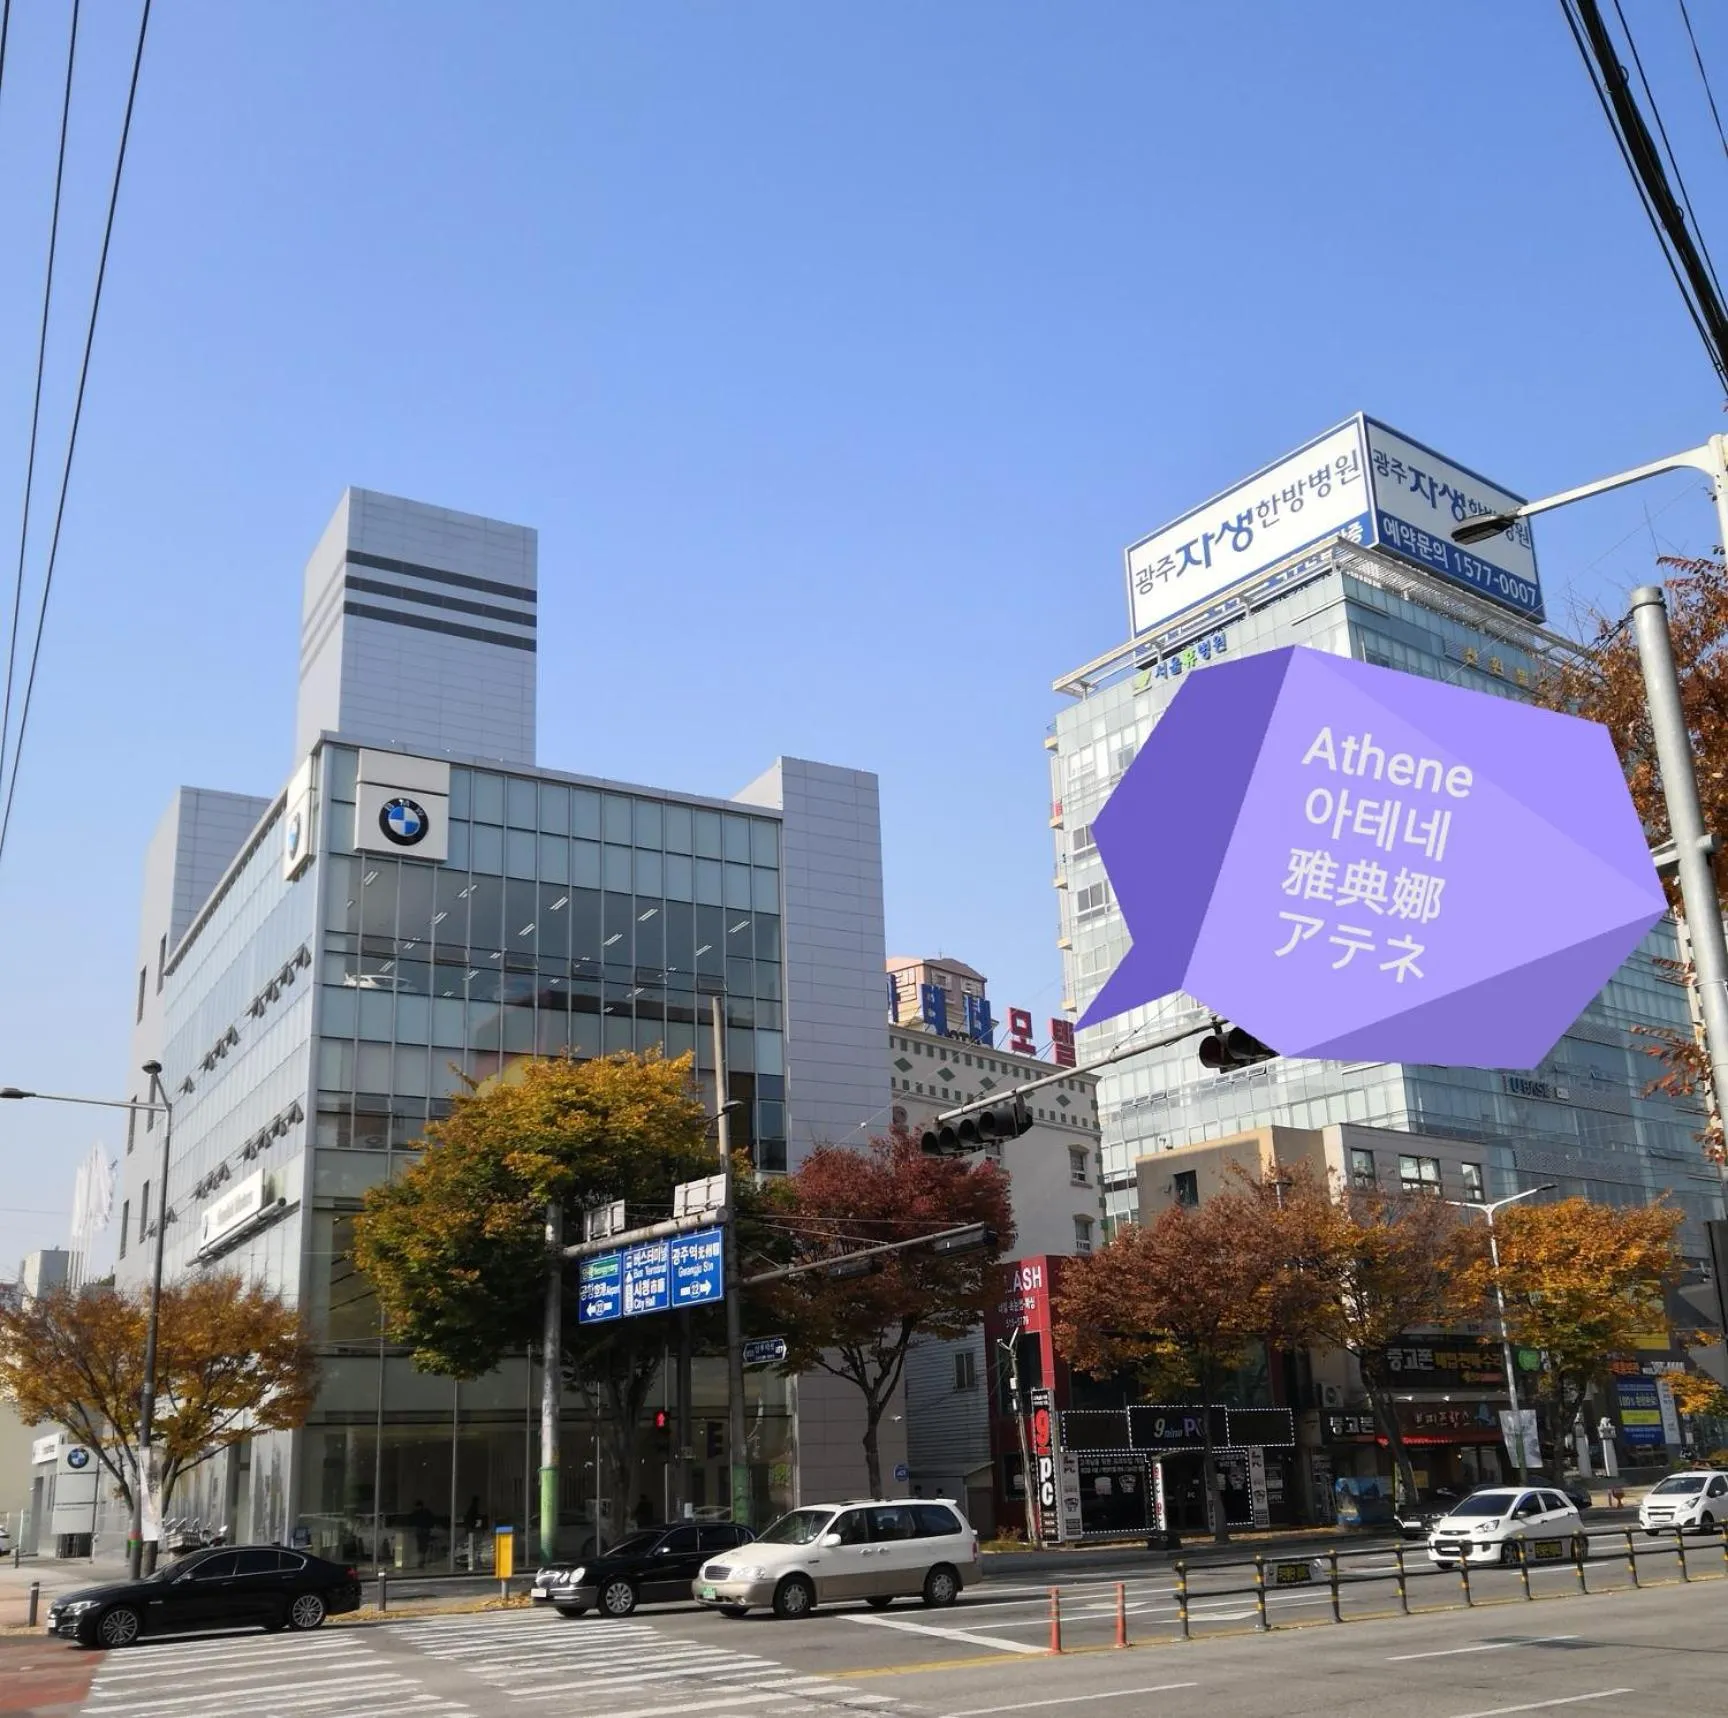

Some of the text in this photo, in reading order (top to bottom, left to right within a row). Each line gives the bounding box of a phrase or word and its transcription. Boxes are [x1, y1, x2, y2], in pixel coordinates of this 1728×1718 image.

[1383, 517, 1537, 607] 예약문의 1577-0007
[1008, 1007, 1077, 1068] 모텔
[1329, 1416, 1375, 1435] 중고폰
